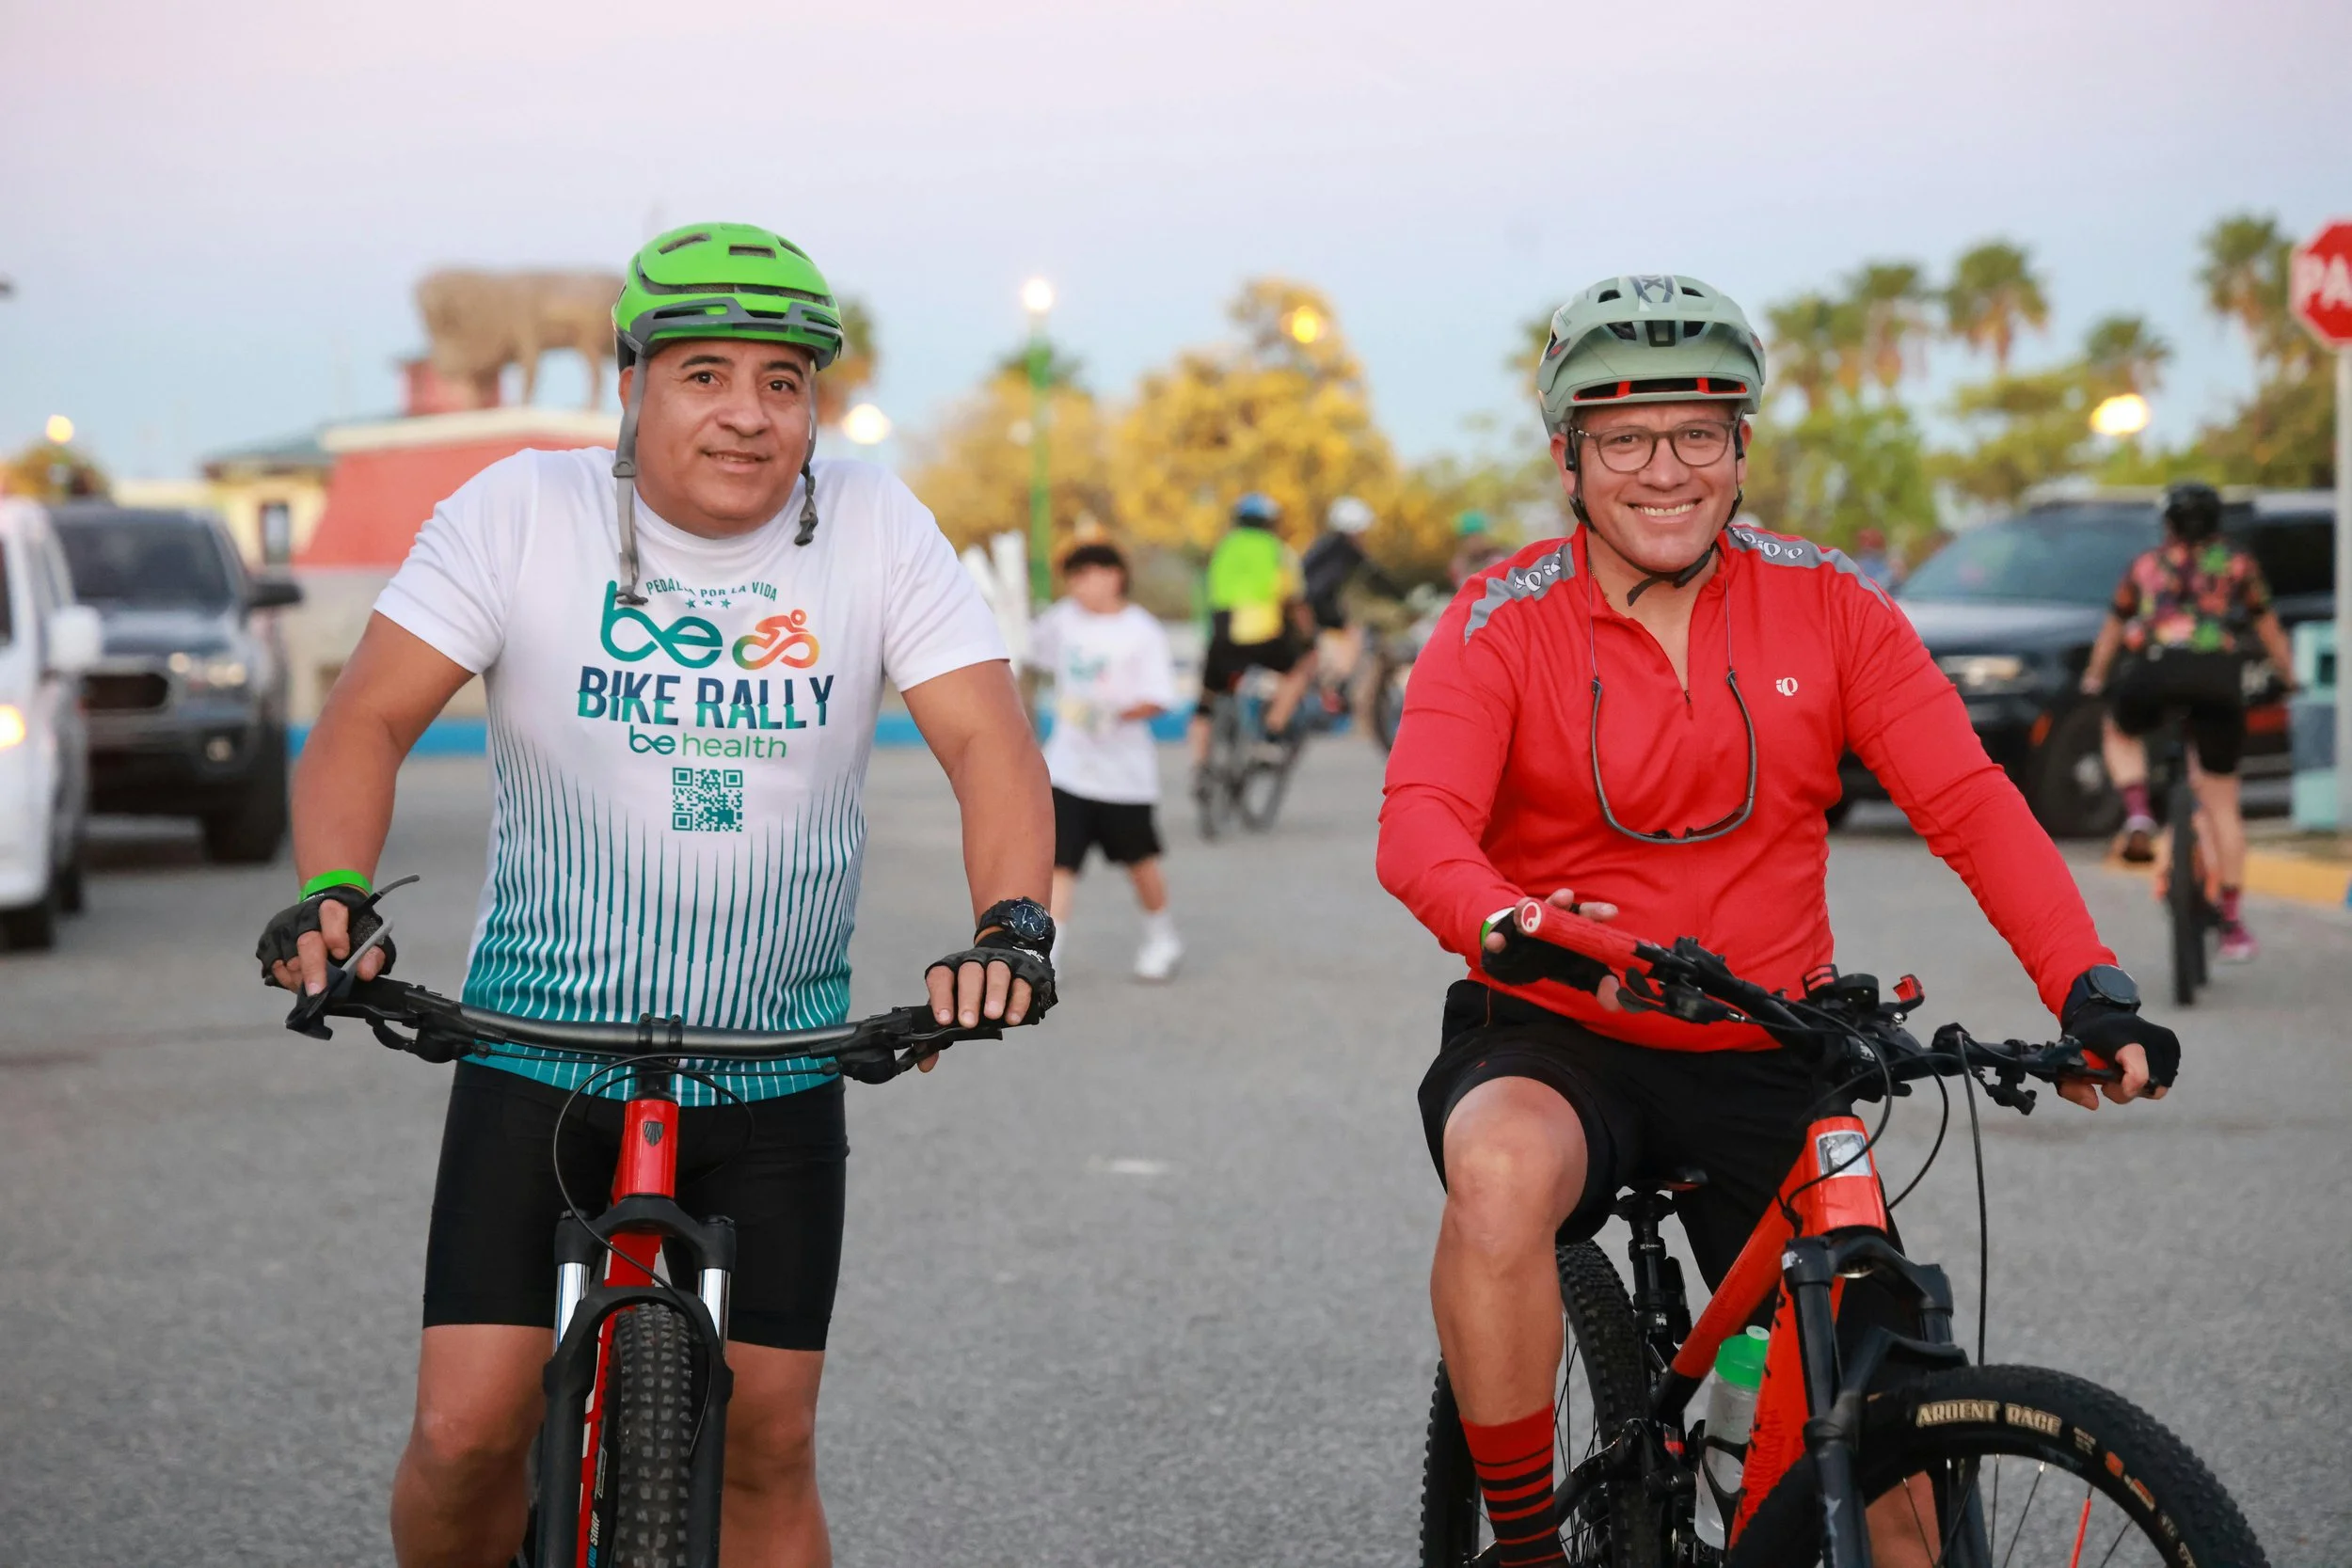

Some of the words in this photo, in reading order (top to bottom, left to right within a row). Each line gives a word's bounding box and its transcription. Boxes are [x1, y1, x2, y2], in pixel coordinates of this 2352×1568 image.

[700, 588, 726, 598] POR
[731, 585, 747, 594] LA
[752, 581, 777, 602] VIDA
[600, 579, 723, 669] be
[577, 666, 681, 726] BIKE
[694, 674, 834, 730] RALLY
[628, 724, 676, 755] be
[682, 732, 787, 759] health
[1915, 1399, 2000, 1428] ARDENT
[2005, 1402, 2062, 1438] RACE
